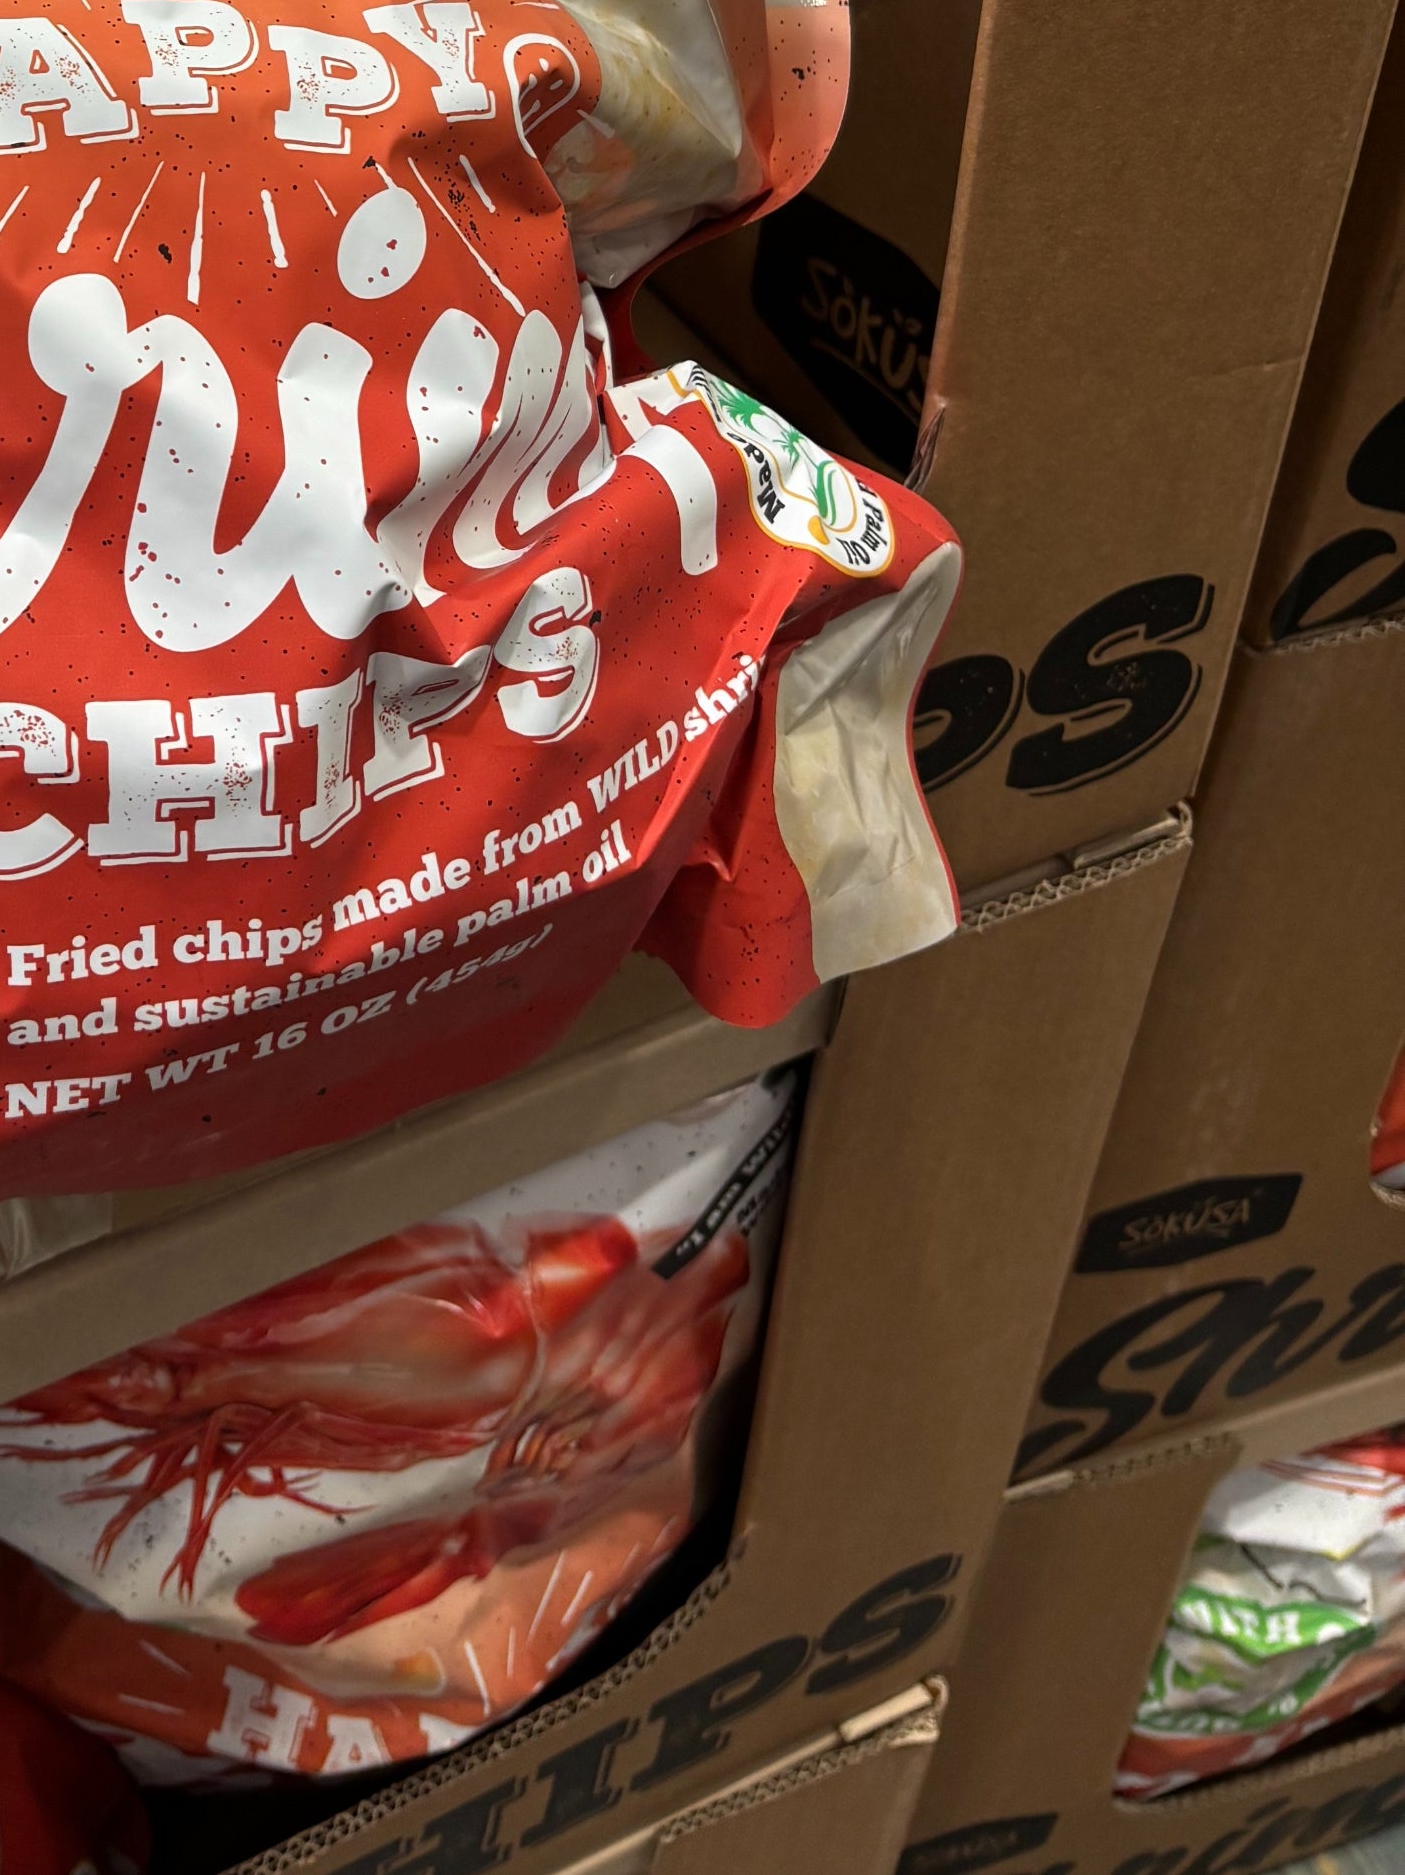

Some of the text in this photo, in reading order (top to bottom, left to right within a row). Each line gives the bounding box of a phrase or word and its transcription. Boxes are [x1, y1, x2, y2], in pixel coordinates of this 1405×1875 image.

[727, 431, 785, 524] Made
[7, 654, 767, 988] Fried chips made from WILD shri
[3, 923, 555, 1121] NET WT 16 OZ (454g)
[7, 819, 633, 1048] and sustainable palm oil
